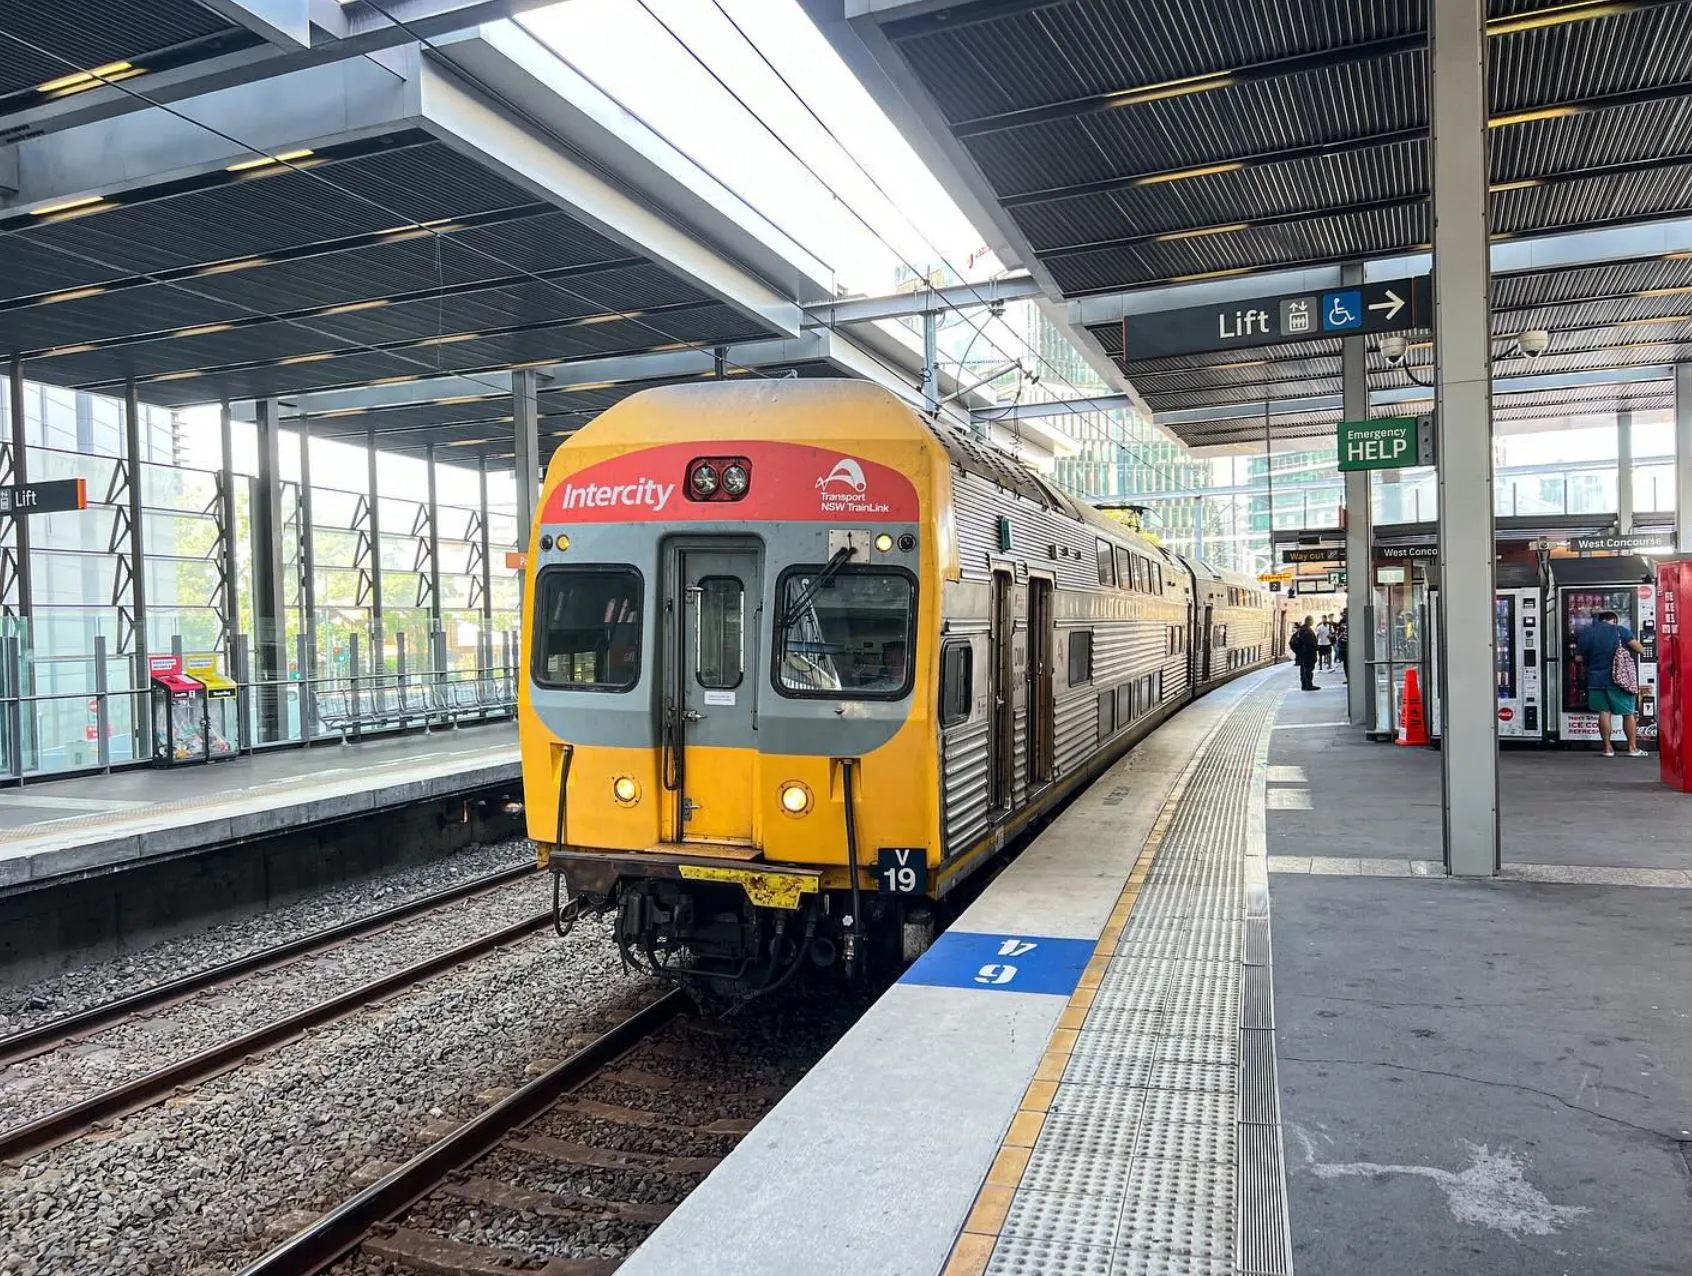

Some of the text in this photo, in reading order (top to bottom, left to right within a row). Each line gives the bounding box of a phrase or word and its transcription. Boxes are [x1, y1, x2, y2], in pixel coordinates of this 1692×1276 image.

[1219, 310, 1270, 339] Lift
[1347, 427, 1407, 441] Emergency
[1347, 439, 1408, 463] HELP
[15, 489, 37, 507] Lift
[562, 477, 675, 511] Intercity
[821, 491, 866, 504] Transport
[821, 502, 890, 513] NSW TrainLink
[1579, 537, 1662, 549] West Concourse
[1290, 551, 1324, 562] Way out
[1384, 547, 1438, 557] West Conco
[895, 849, 910, 866] V
[883, 867, 917, 893] 19
[997, 939, 1038, 957] 4
